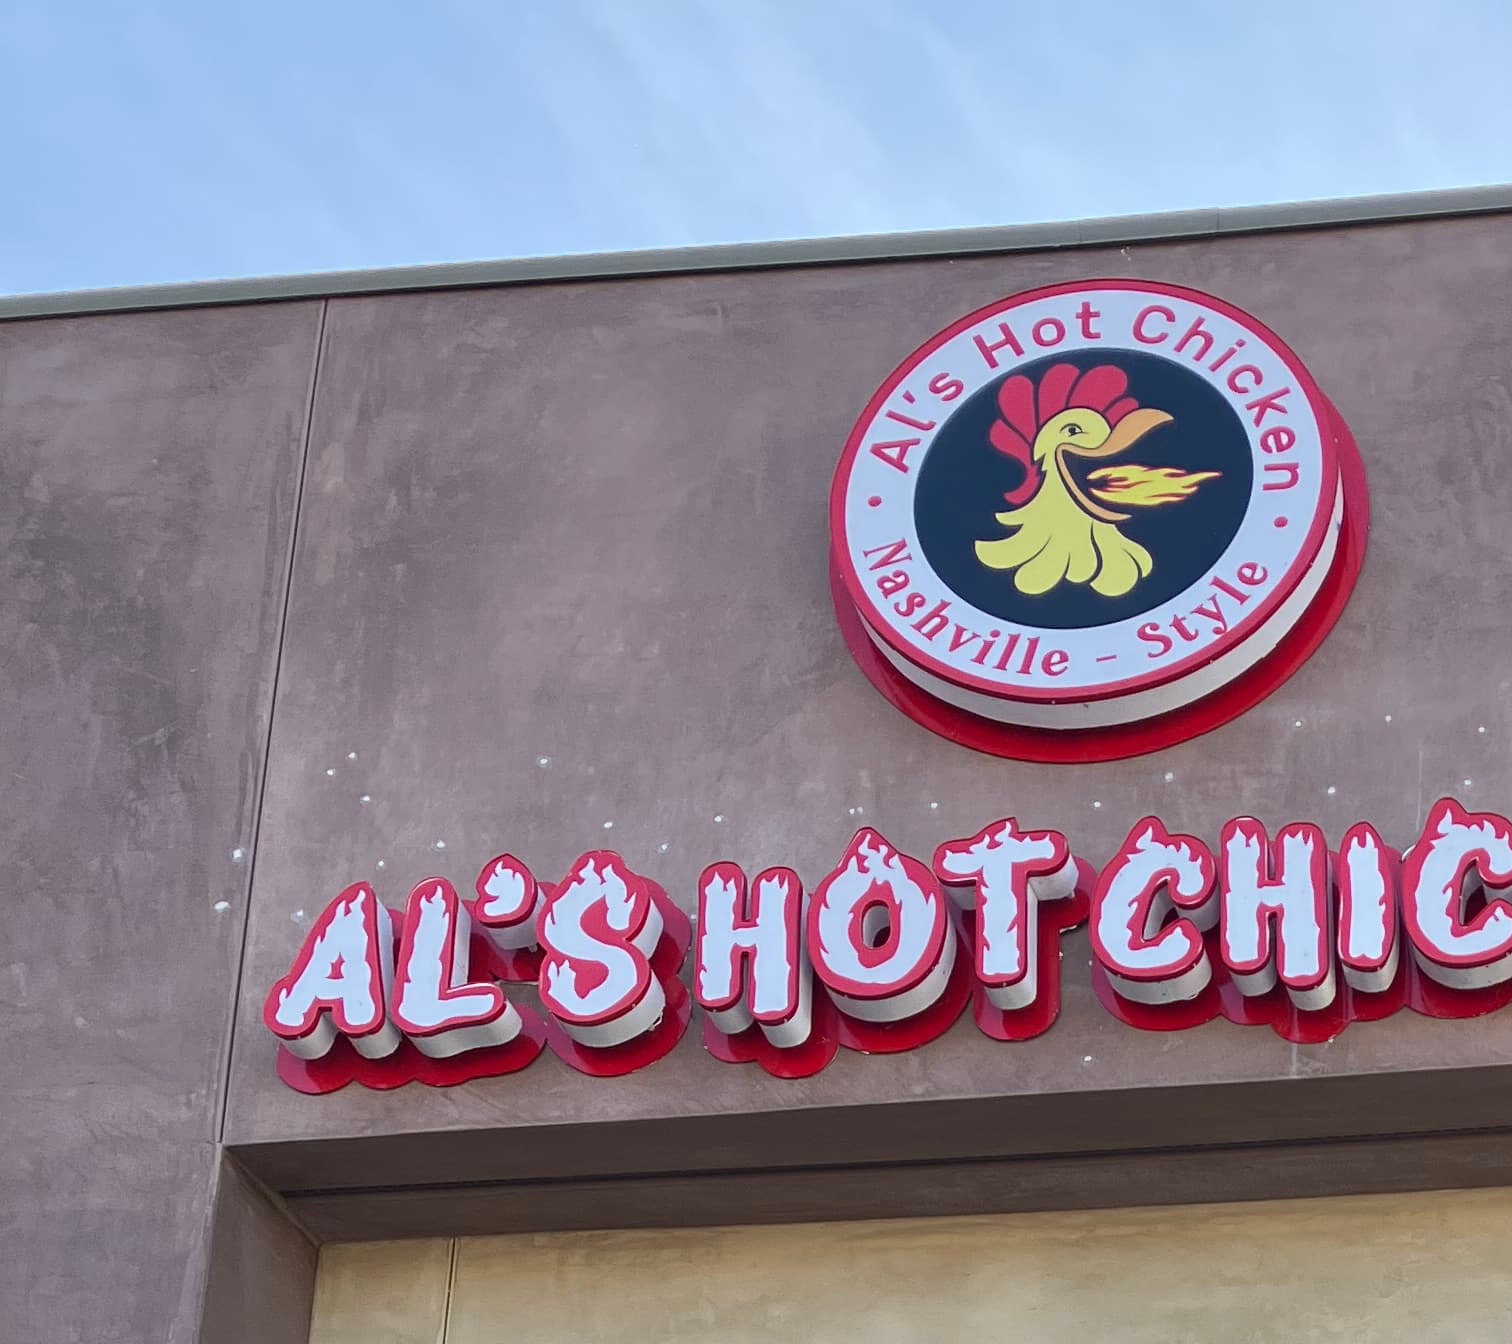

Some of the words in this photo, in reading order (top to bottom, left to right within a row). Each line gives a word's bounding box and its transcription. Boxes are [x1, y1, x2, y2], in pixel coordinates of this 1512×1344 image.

[868, 370, 966, 474] Al's
[972, 301, 1102, 370] Hot
[1131, 304, 1300, 493] Chicken
[862, 538, 1071, 678] Nashville
[1135, 560, 1269, 660] Style
[264, 850, 664, 1038] AL'S
[692, 816, 1072, 1042] HOT
